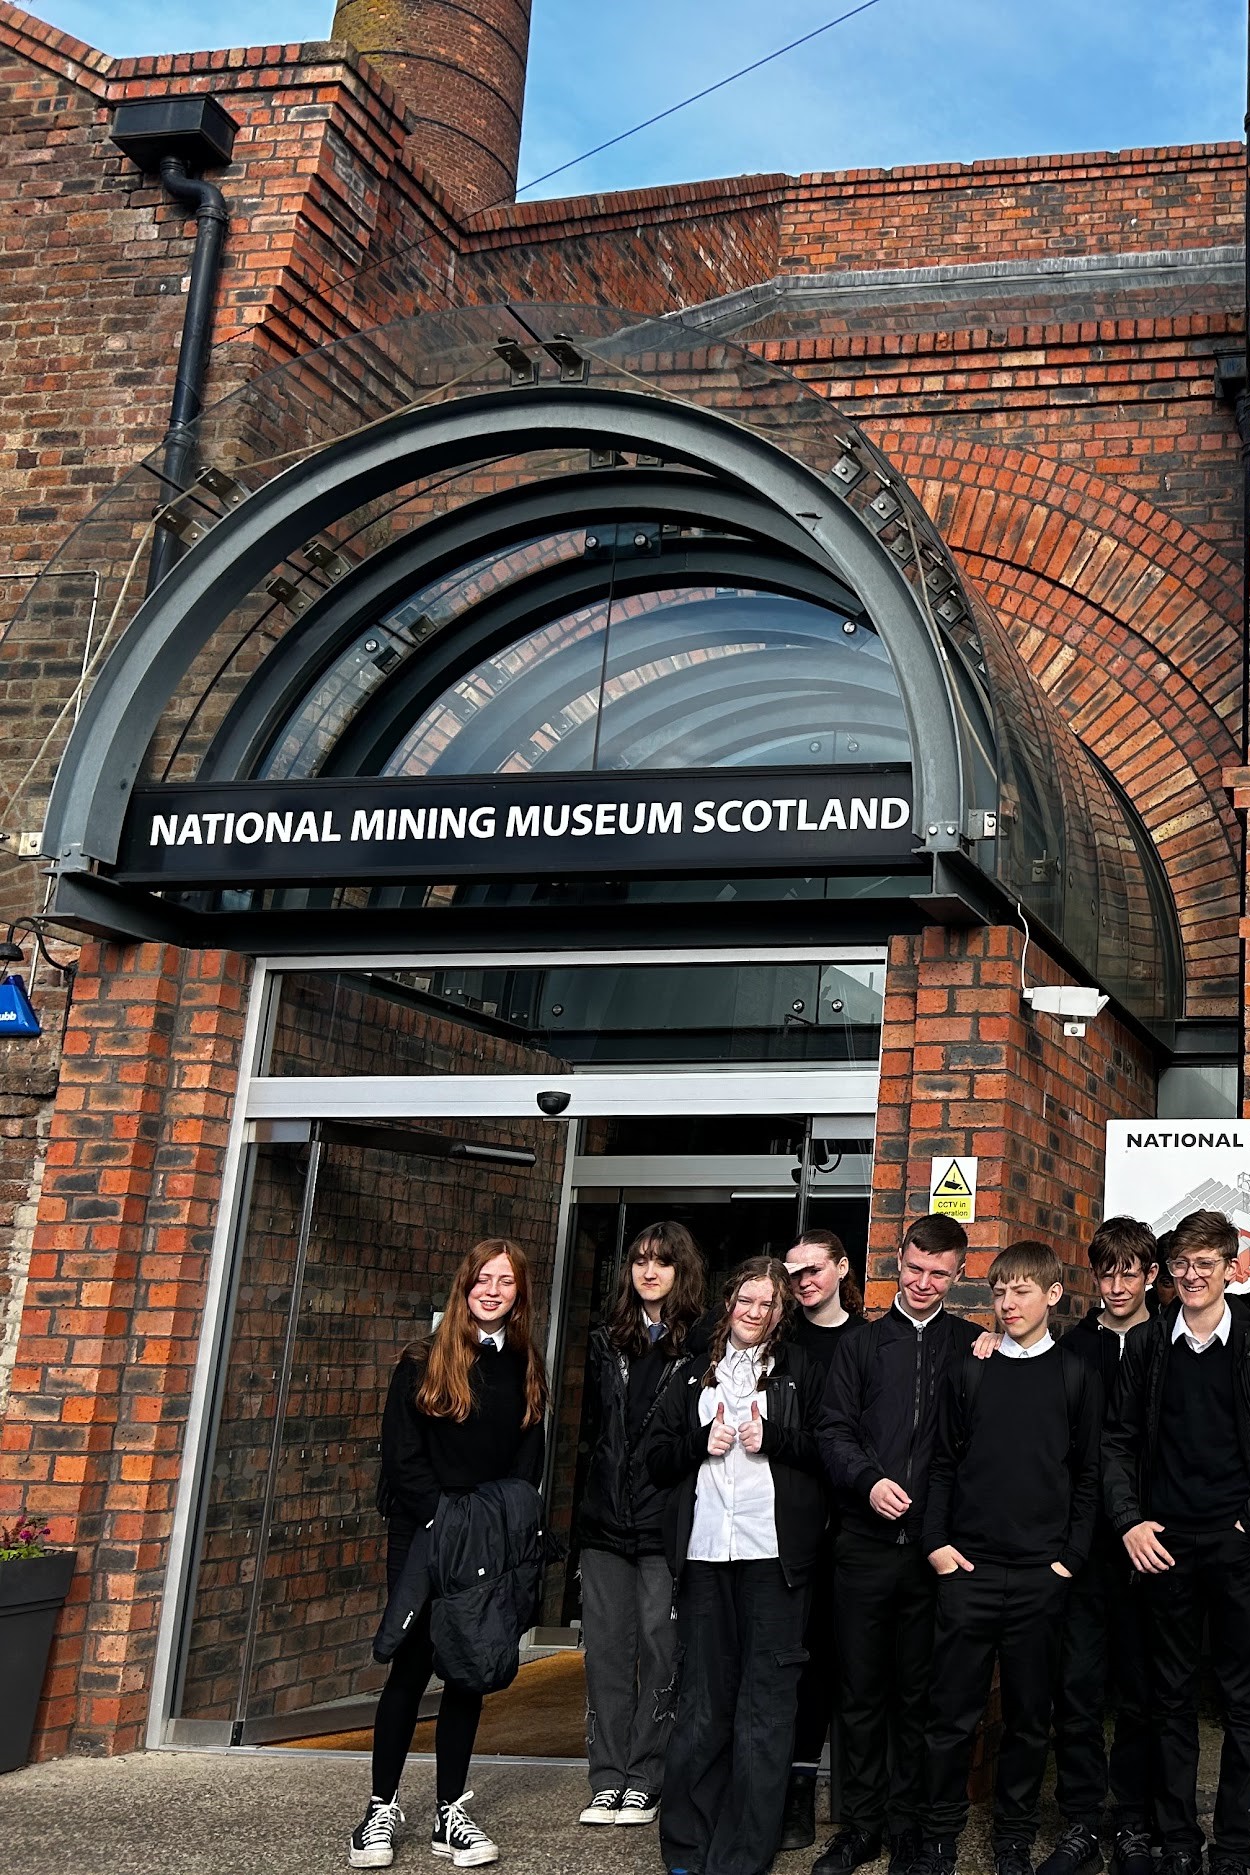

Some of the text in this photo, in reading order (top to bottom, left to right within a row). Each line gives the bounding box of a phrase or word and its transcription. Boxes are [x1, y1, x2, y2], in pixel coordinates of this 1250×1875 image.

[149, 797, 911, 846] NATIONAL MINING MUSEUM SCOTLAND
[0, 1011, 16, 1021] ubb
[1126, 1133, 1244, 1148] NATIONAL
